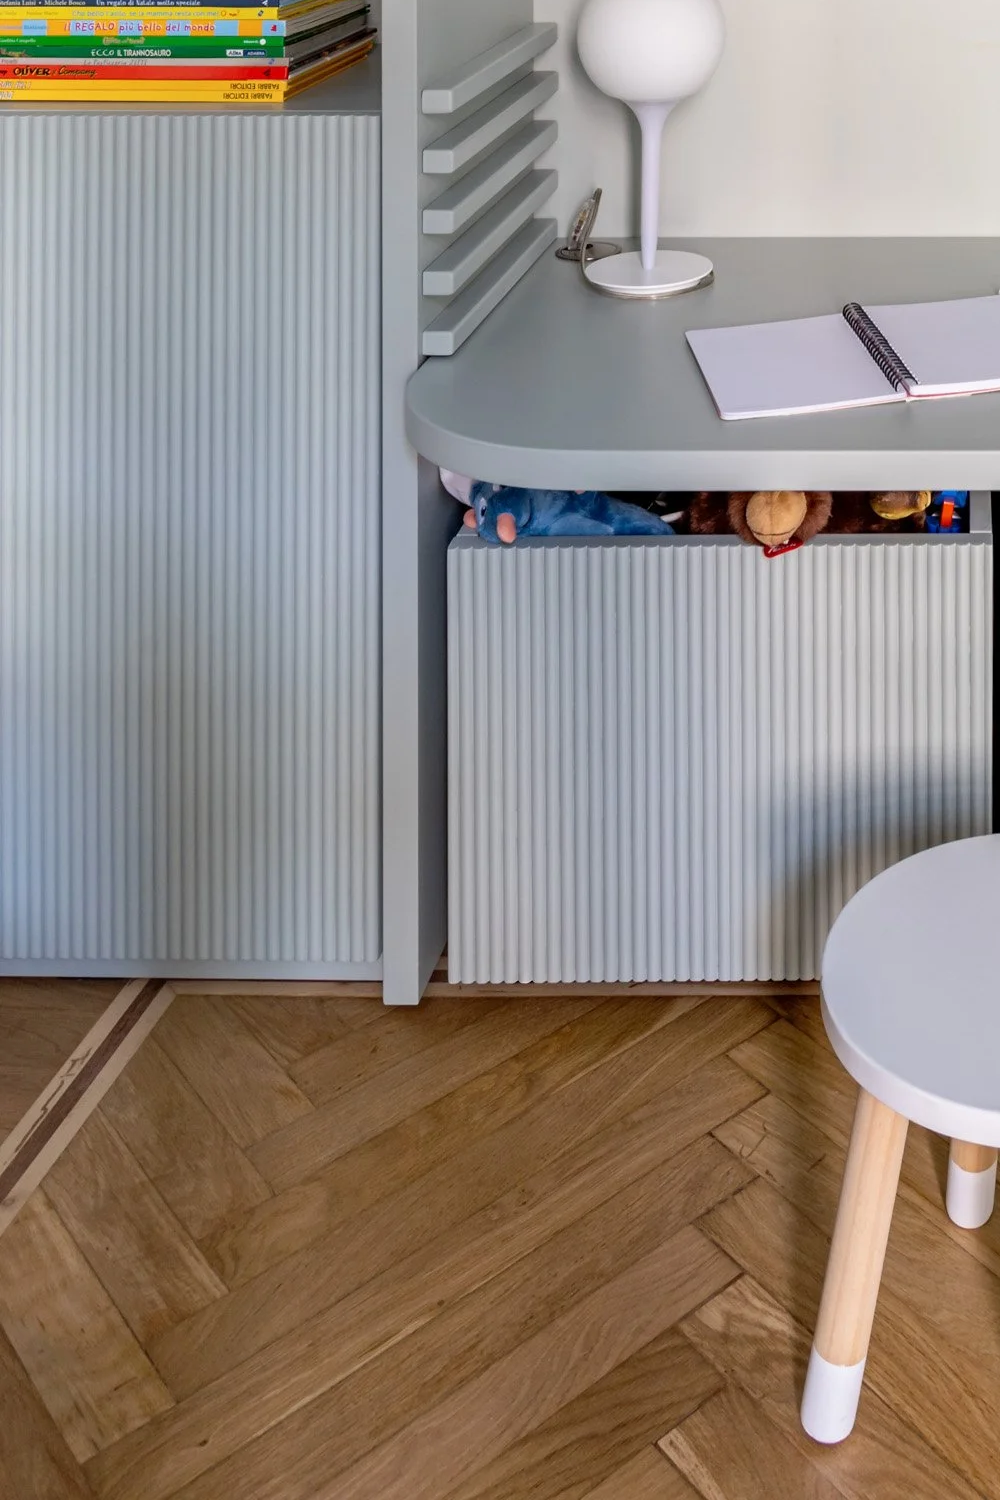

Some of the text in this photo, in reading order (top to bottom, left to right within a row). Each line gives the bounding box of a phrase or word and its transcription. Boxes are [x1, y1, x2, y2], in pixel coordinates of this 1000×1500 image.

[107, 0, 126, 8] regalo
[176, 0, 201, 8] speciale
[75, 22, 115, 32] REGALO
[119, 22, 134, 34] più
[137, 22, 161, 32] bello
[165, 22, 181, 31] del
[184, 22, 215, 31] mondo
[13, 65, 50, 77] OLIVER
[58, 65, 97, 79] Company
